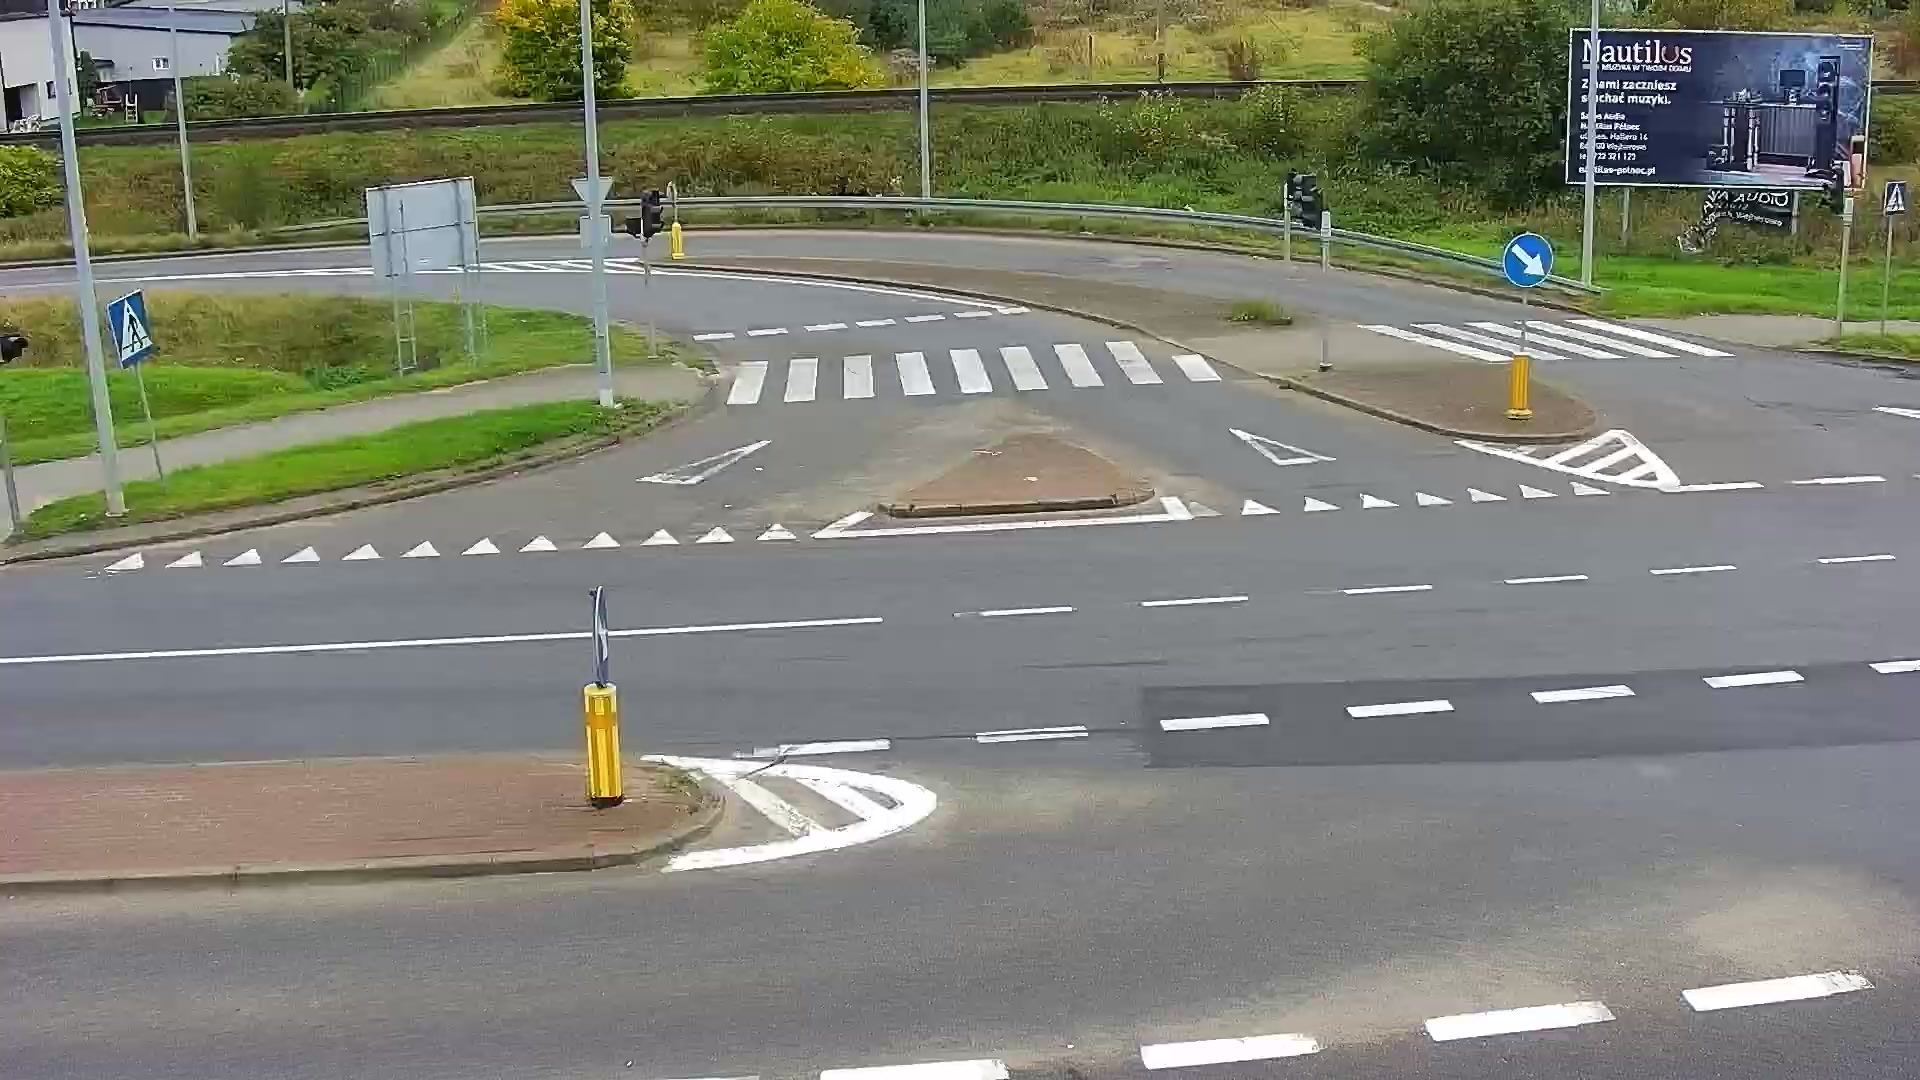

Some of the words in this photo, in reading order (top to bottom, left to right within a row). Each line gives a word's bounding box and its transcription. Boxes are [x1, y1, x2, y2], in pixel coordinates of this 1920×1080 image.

[1582, 38, 1693, 65] Nautilus
[1581, 78, 1589, 89] Z
[1622, 80, 1677, 91] zaczniesz
[1581, 91, 1625, 103] schać
[1580, 122, 1612, 130] Ntilus
[1578, 165, 1656, 177] natilus-polnoc.pl
[1733, 191, 1789, 207] AUDIO
